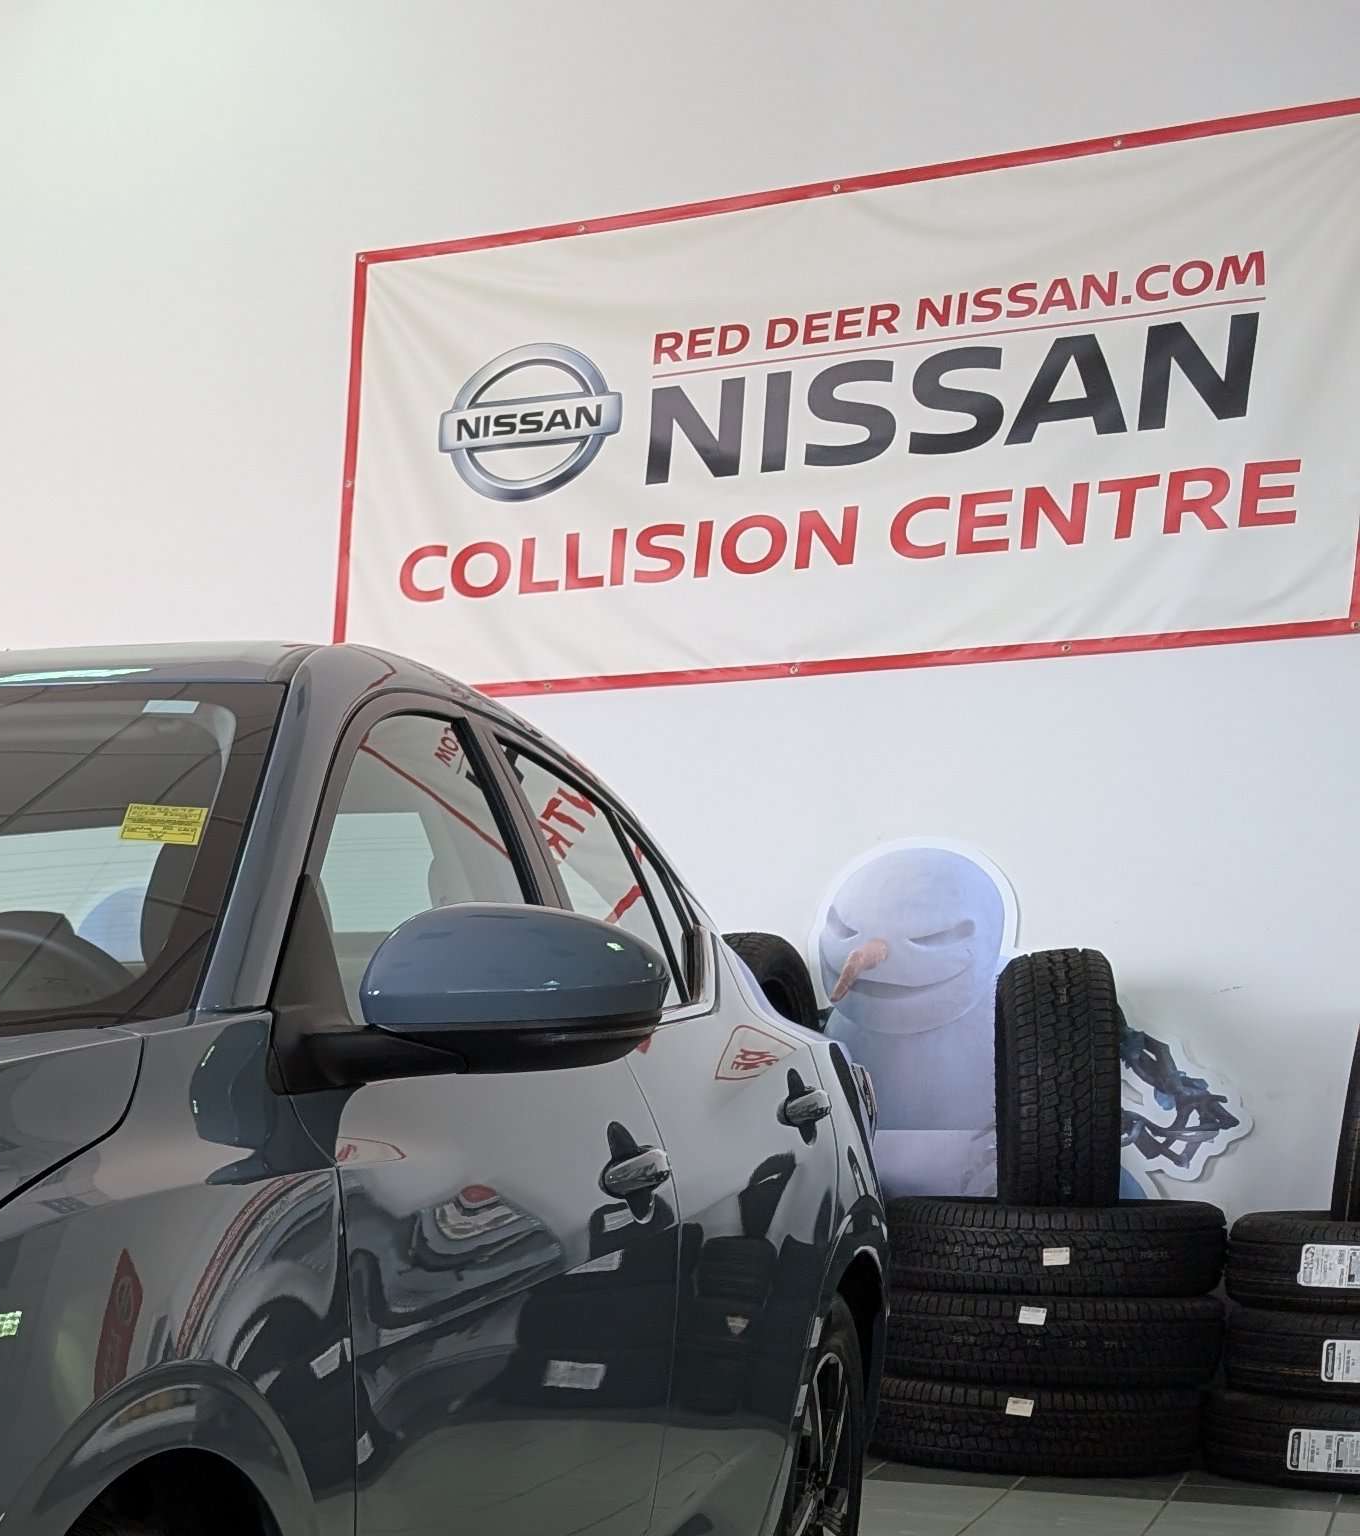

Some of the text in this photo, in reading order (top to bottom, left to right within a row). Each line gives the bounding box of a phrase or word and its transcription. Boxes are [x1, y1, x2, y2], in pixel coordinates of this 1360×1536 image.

[653, 250, 1267, 365] RED DEER NISSAN.COM
[455, 403, 603, 442] NISSAN
[644, 311, 1261, 486] NISSAN
[398, 459, 1303, 603] COLLISION CENTRE
